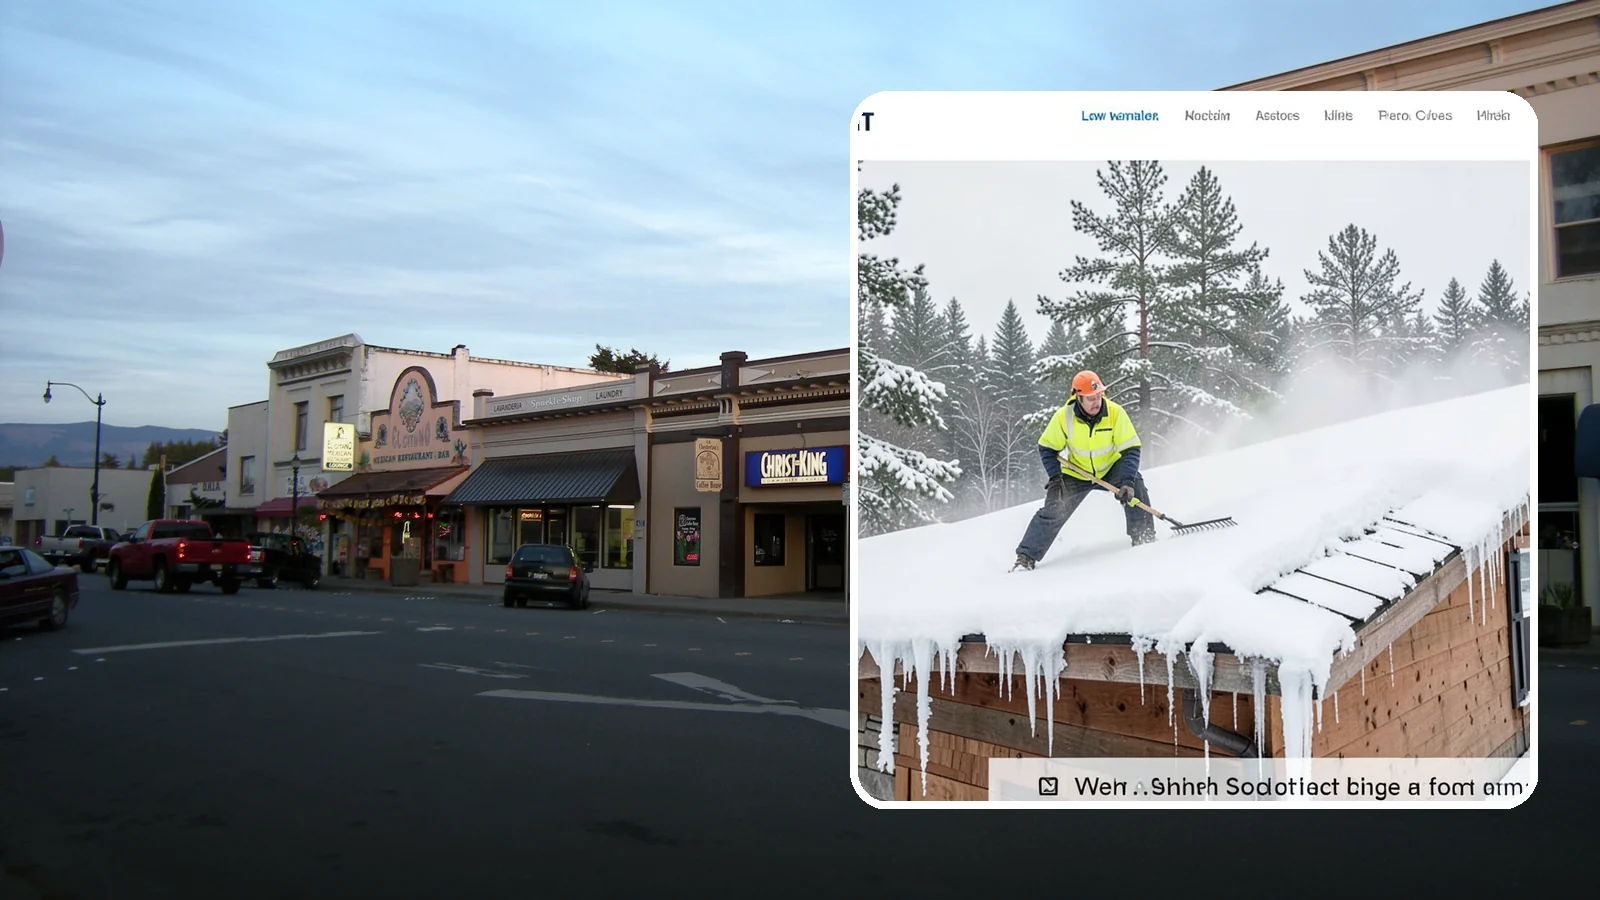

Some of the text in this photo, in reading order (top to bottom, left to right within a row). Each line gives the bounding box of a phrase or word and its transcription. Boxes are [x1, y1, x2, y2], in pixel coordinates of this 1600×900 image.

[595, 388, 624, 400] LAUNDRY
[493, 402, 523, 413] LAVANDERIA
[530, 394, 583, 409] Sparkle Shop
[373, 454, 396, 464] MEXICAN
[397, 451, 434, 463] RESTAURANT
[437, 450, 450, 459] BAR
[760, 449, 828, 478] CHRIST KING
[696, 480, 710, 489] Coffee
